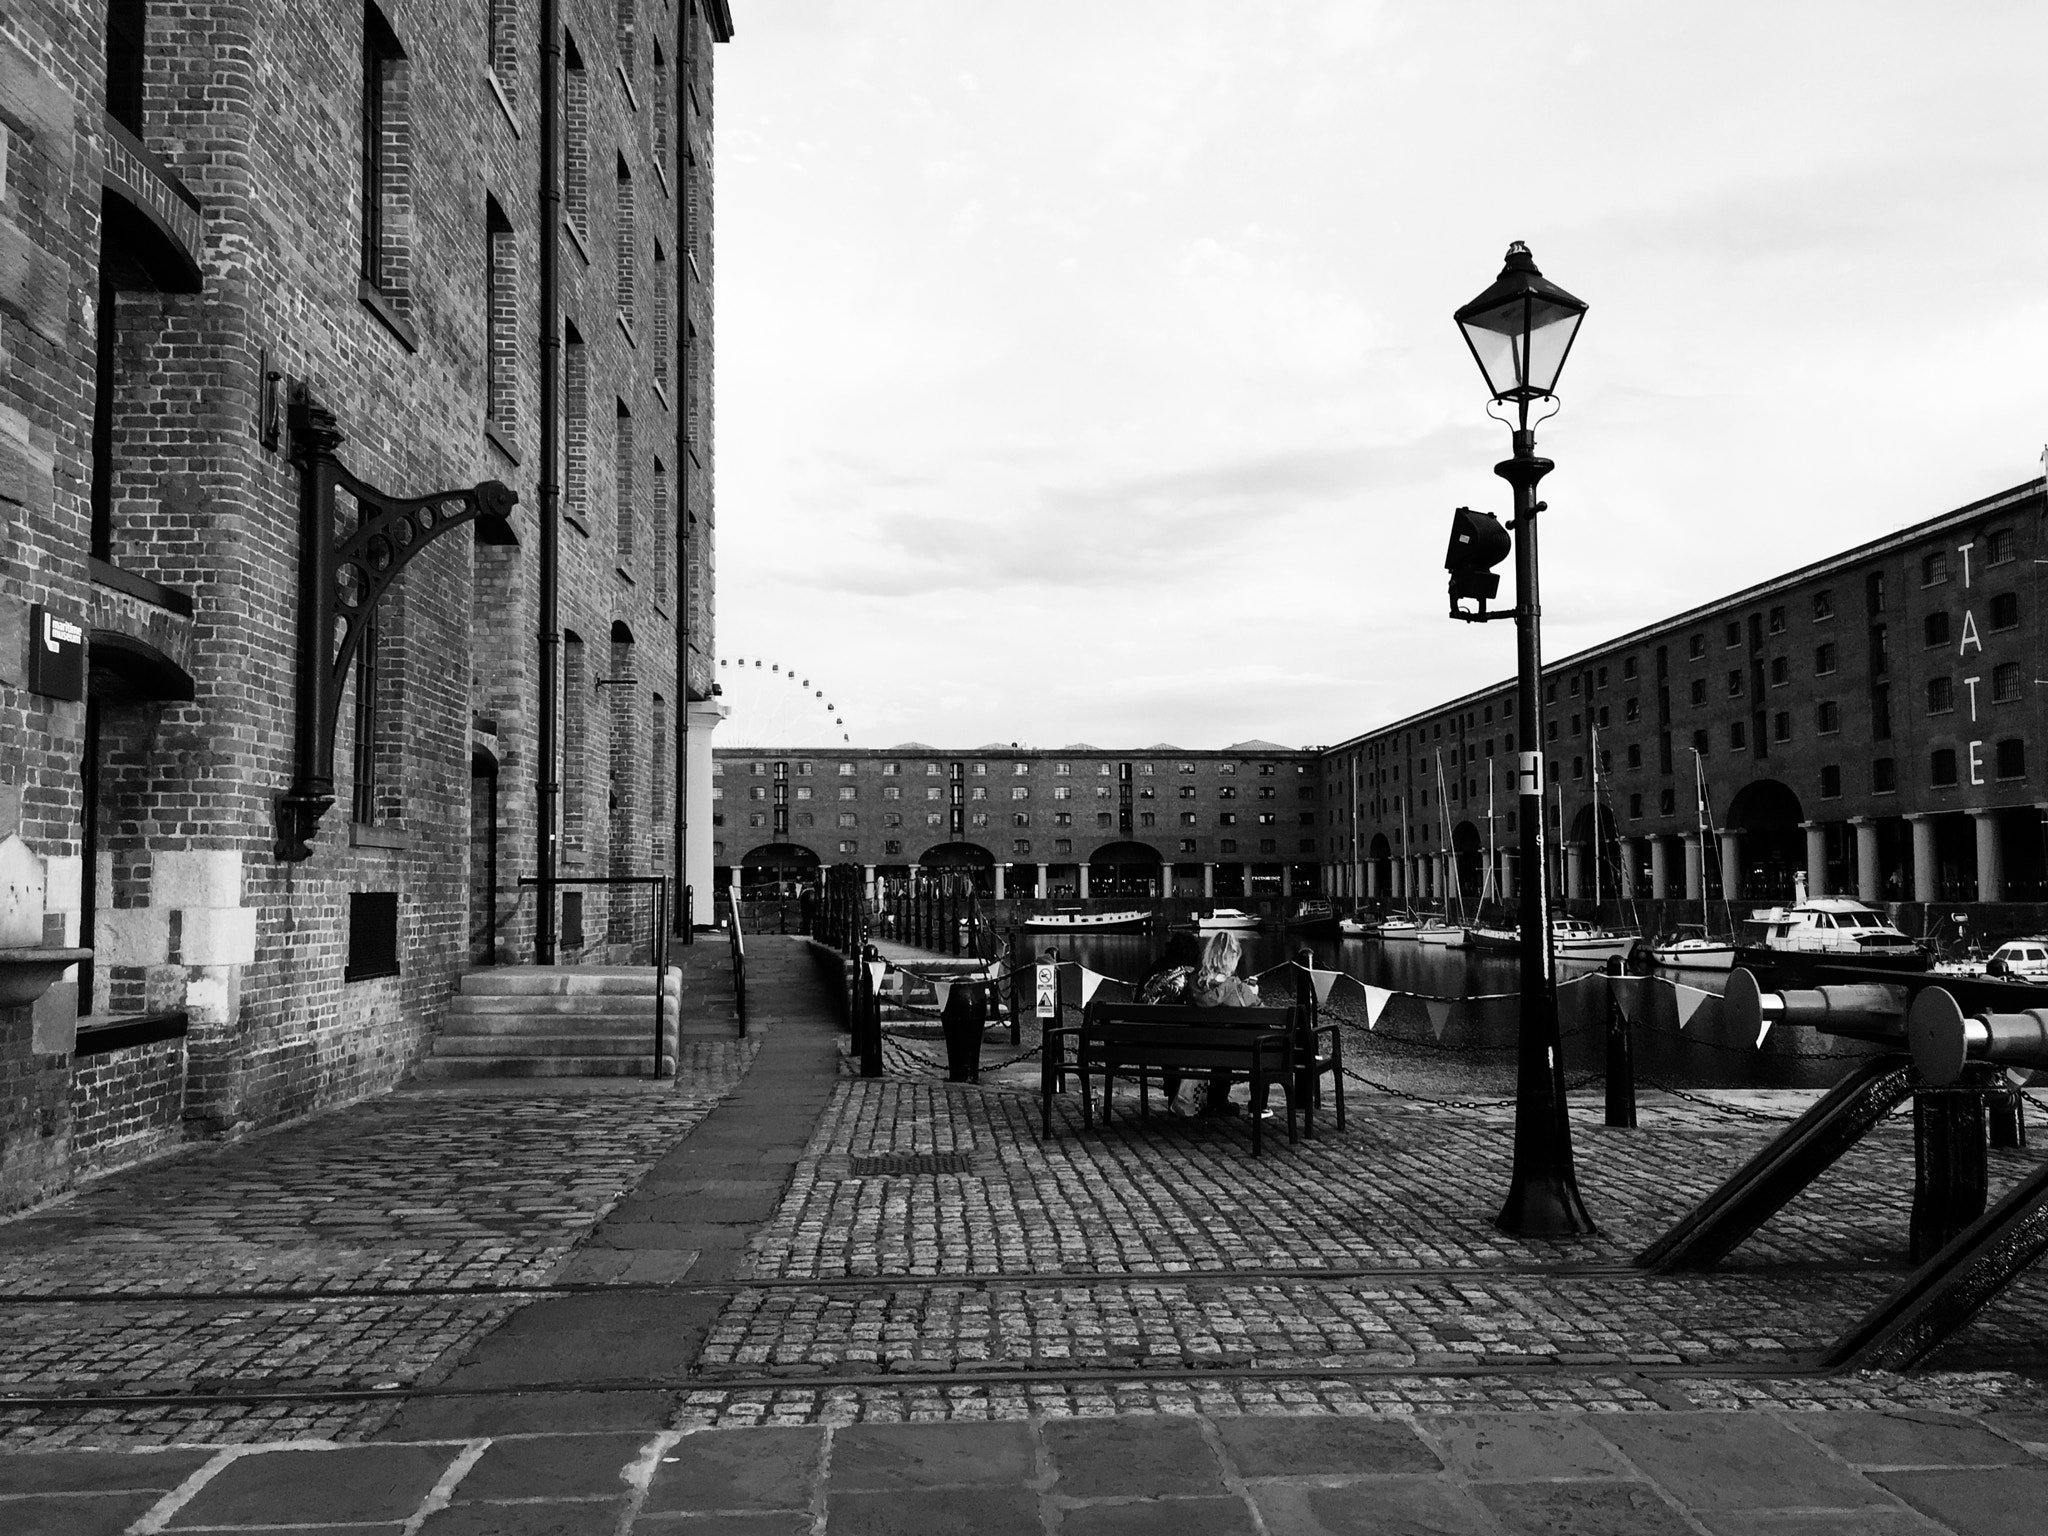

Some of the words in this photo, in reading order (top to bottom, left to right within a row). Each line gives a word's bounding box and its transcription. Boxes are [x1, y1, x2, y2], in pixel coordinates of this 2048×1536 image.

[52, 620, 82, 637] maritime
[52, 628, 81, 644] museum
[1958, 542, 1984, 785] TATE
